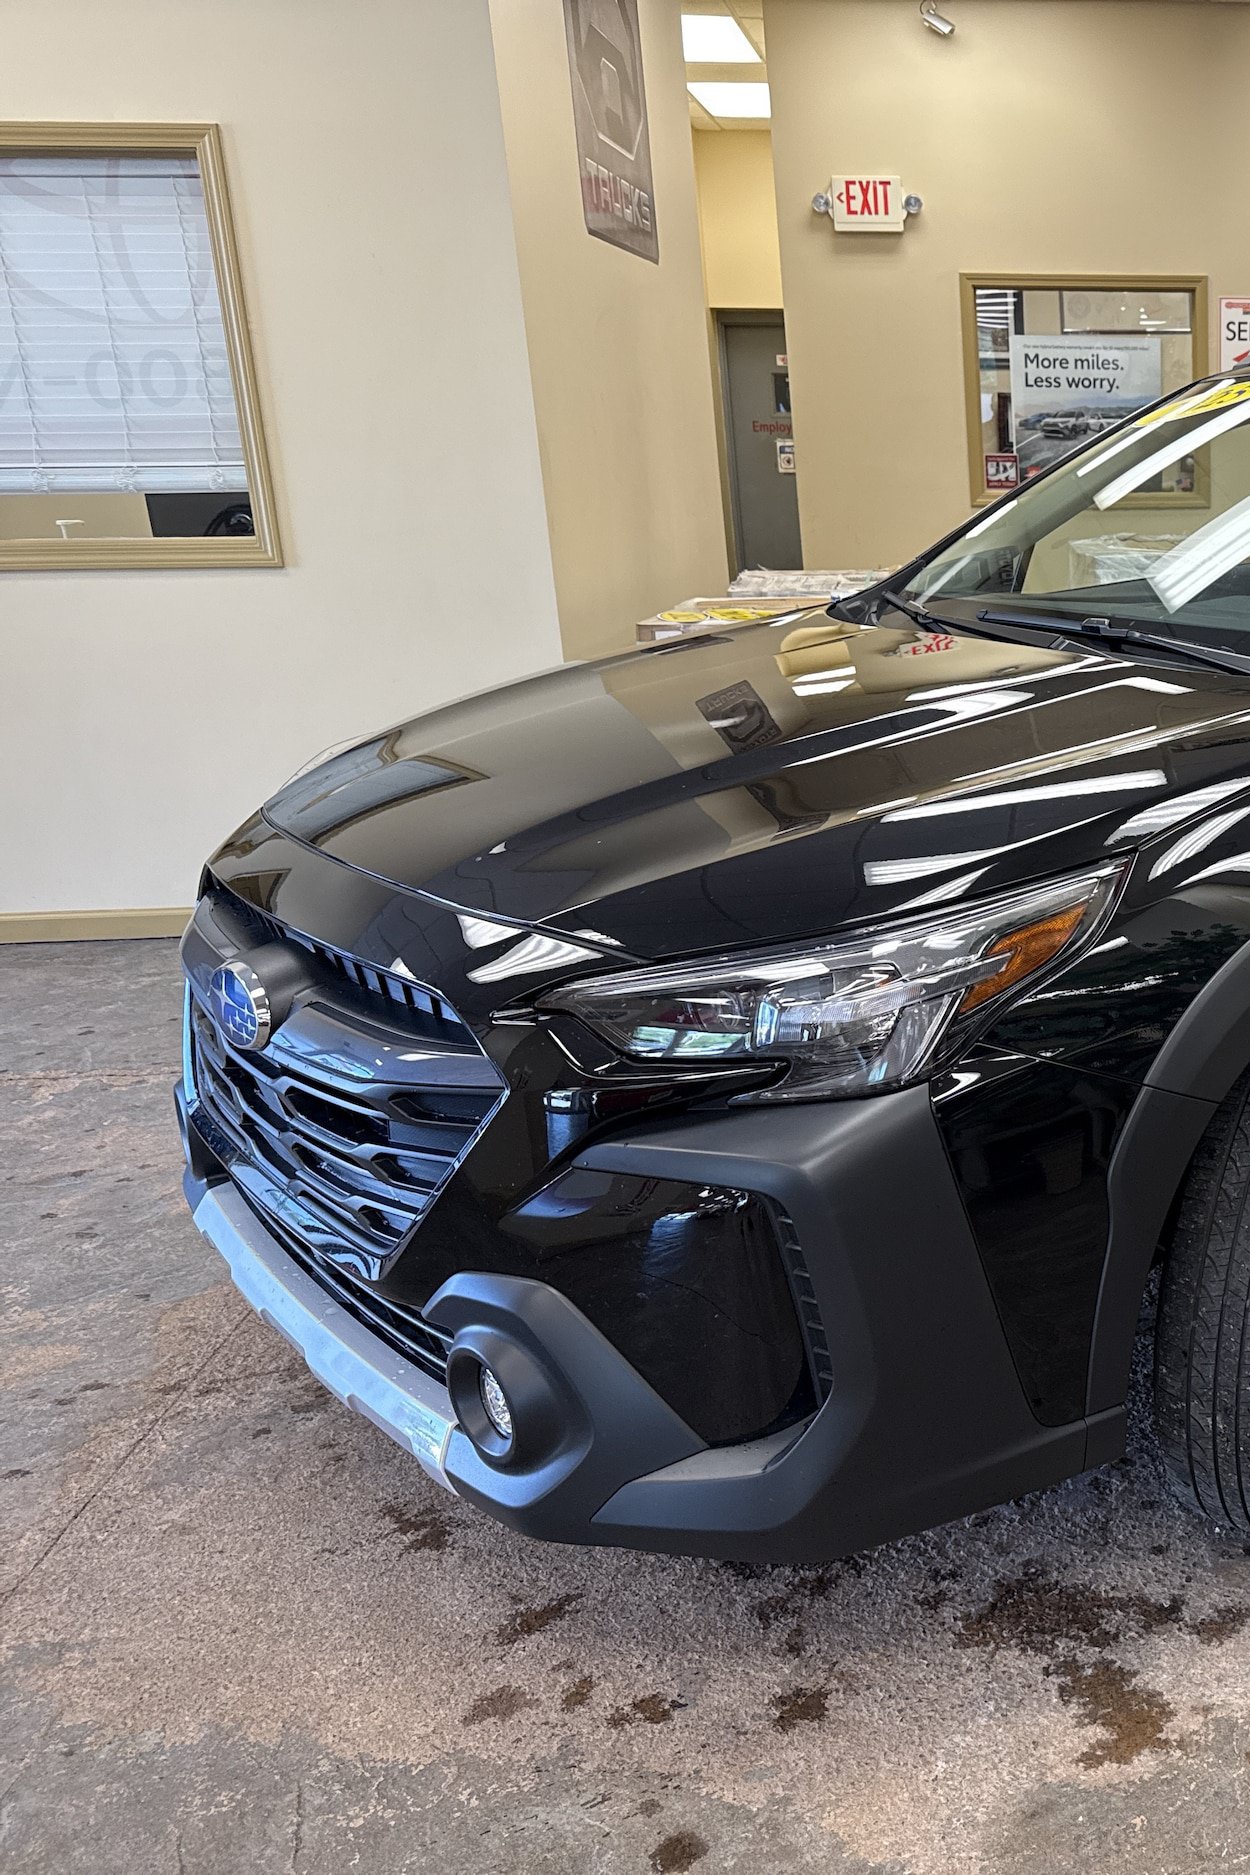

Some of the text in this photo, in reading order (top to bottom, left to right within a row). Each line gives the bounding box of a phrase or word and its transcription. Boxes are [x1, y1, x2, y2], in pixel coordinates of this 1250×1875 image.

[585, 157, 651, 232] TRUCKS
[844, 180, 891, 215] EXIT
[1024, 353, 1124, 370] More miles.
[1025, 372, 1119, 393] Less worry.
